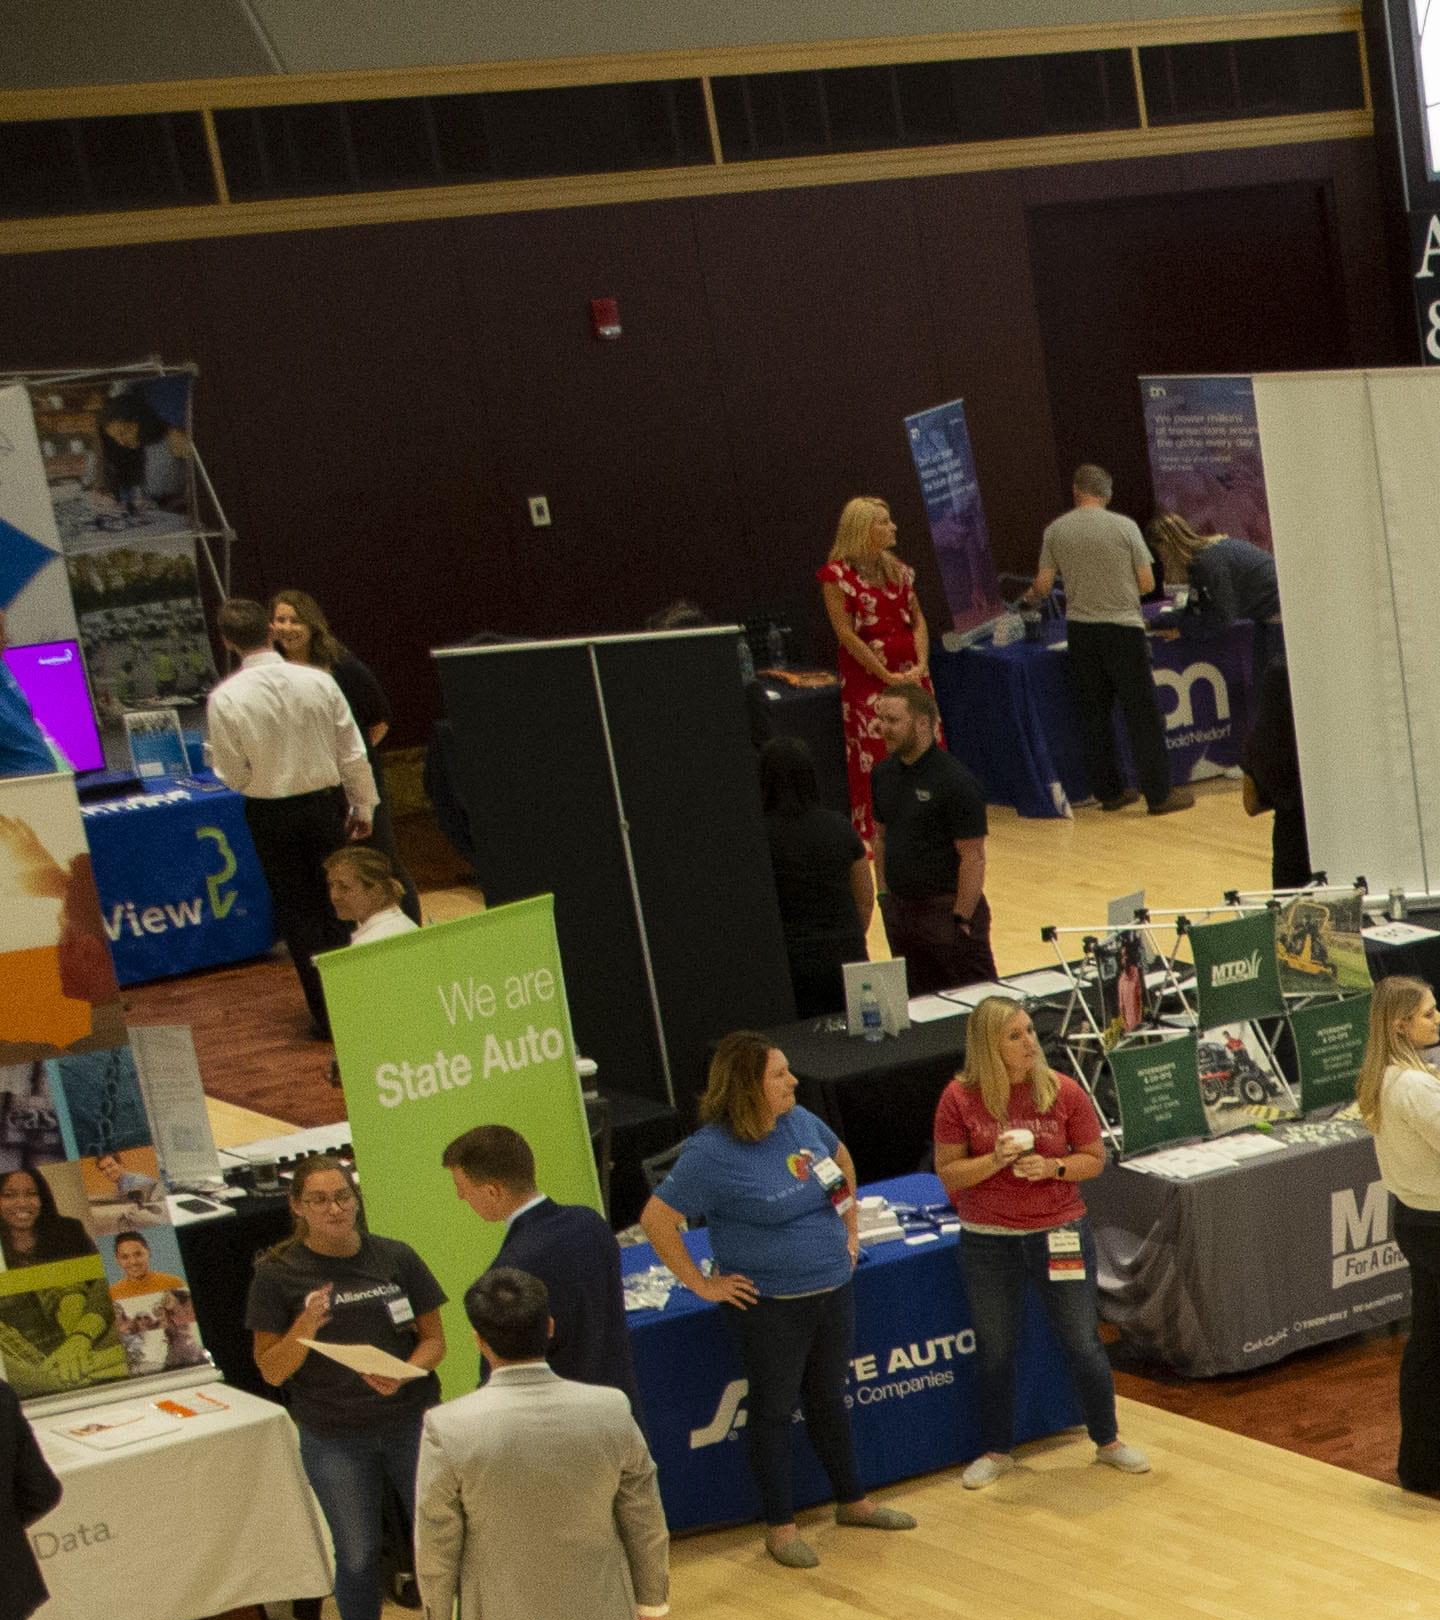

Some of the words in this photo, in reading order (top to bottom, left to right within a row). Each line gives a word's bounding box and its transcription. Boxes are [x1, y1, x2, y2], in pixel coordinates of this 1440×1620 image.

[1211, 961, 1247, 981] MTD
[438, 984, 496, 1027] We
[504, 965, 555, 1006] are
[374, 1050, 473, 1109] State
[481, 1022, 566, 1080] Auto
[335, 1283, 401, 1305] AllianceData
[888, 1329, 978, 1374] AUTO
[857, 1369, 955, 1406] Companies
[32, 1518, 112, 1562] Data
